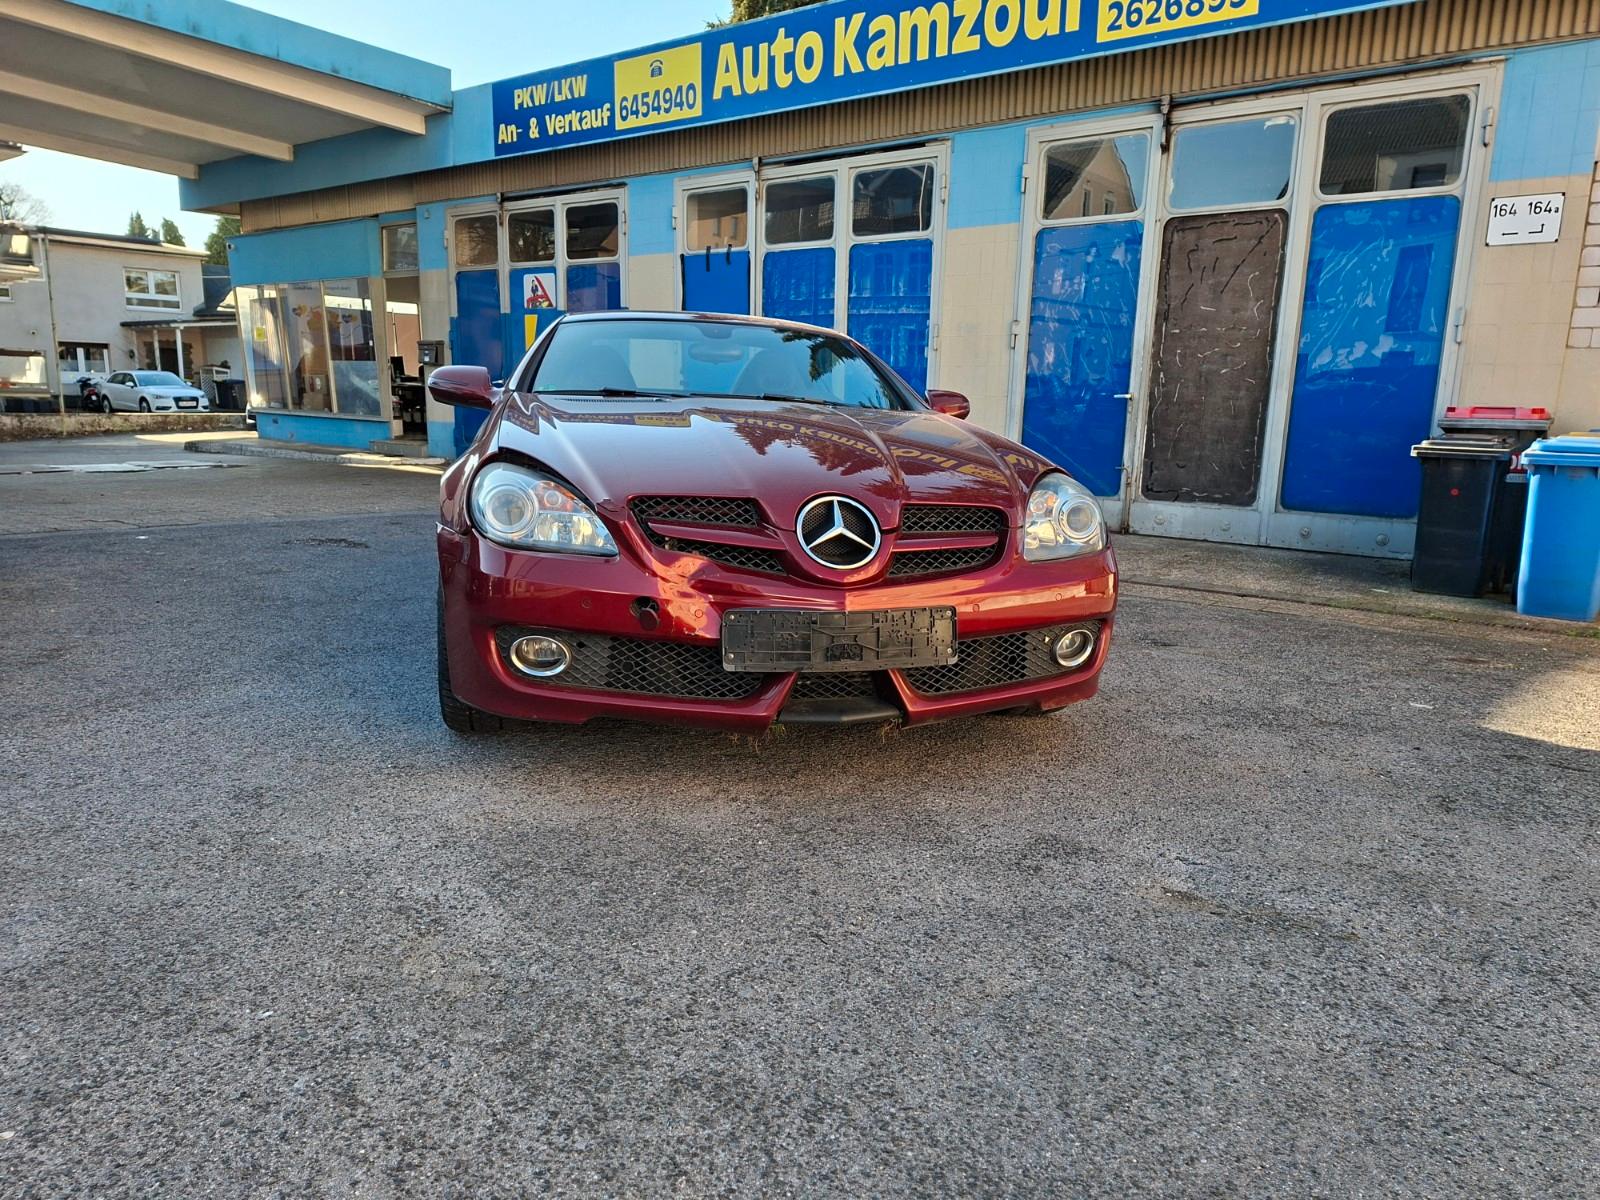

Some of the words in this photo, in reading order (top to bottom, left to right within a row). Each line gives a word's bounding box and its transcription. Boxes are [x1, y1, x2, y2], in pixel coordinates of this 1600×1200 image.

[1106, 0, 1254, 33] 26268
[712, 27, 825, 101] Auto
[513, 74, 588, 110] PKW/LKW
[619, 82, 697, 122] 6454940
[497, 123, 523, 145] An-
[528, 117, 539, 140] &
[545, 103, 611, 136] Verkauf
[1493, 203, 1518, 218] 164
